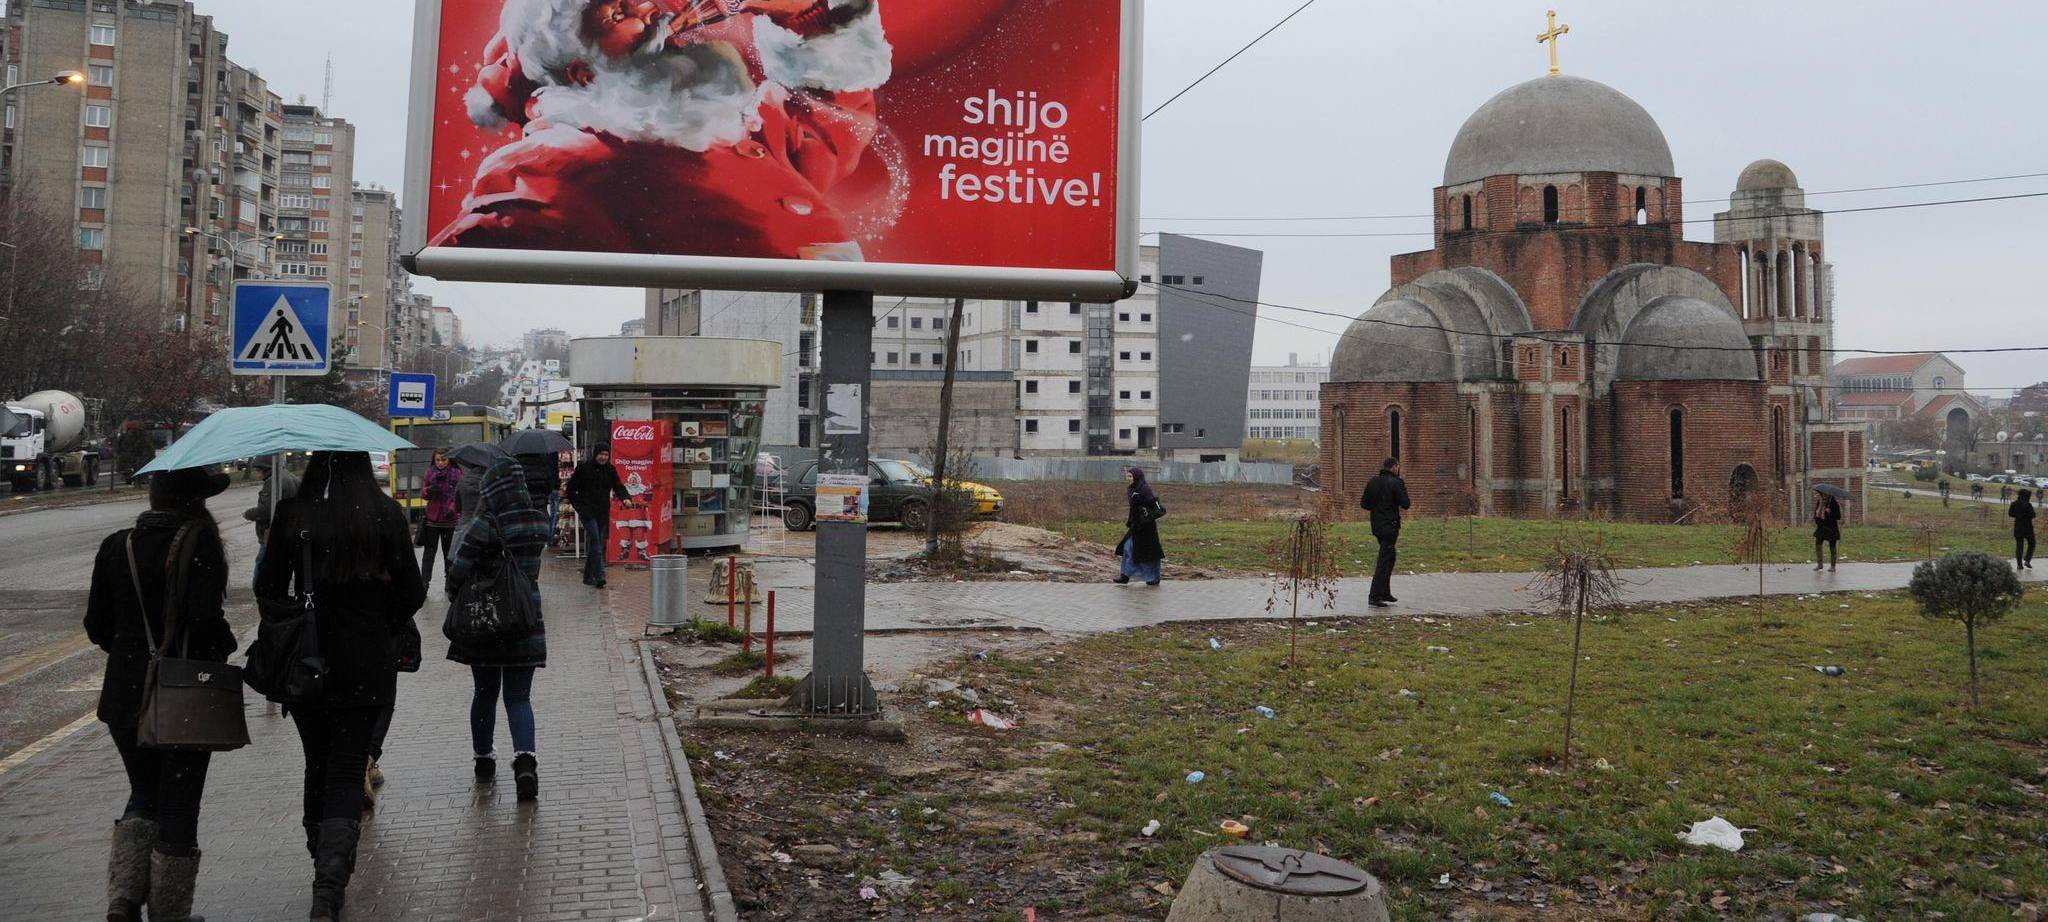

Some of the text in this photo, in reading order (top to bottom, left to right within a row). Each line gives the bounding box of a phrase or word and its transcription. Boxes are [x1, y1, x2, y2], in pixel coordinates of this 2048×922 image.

[963, 88, 1068, 135] shijo
[924, 131, 1070, 167] magjinë
[938, 163, 1100, 207] festive!
